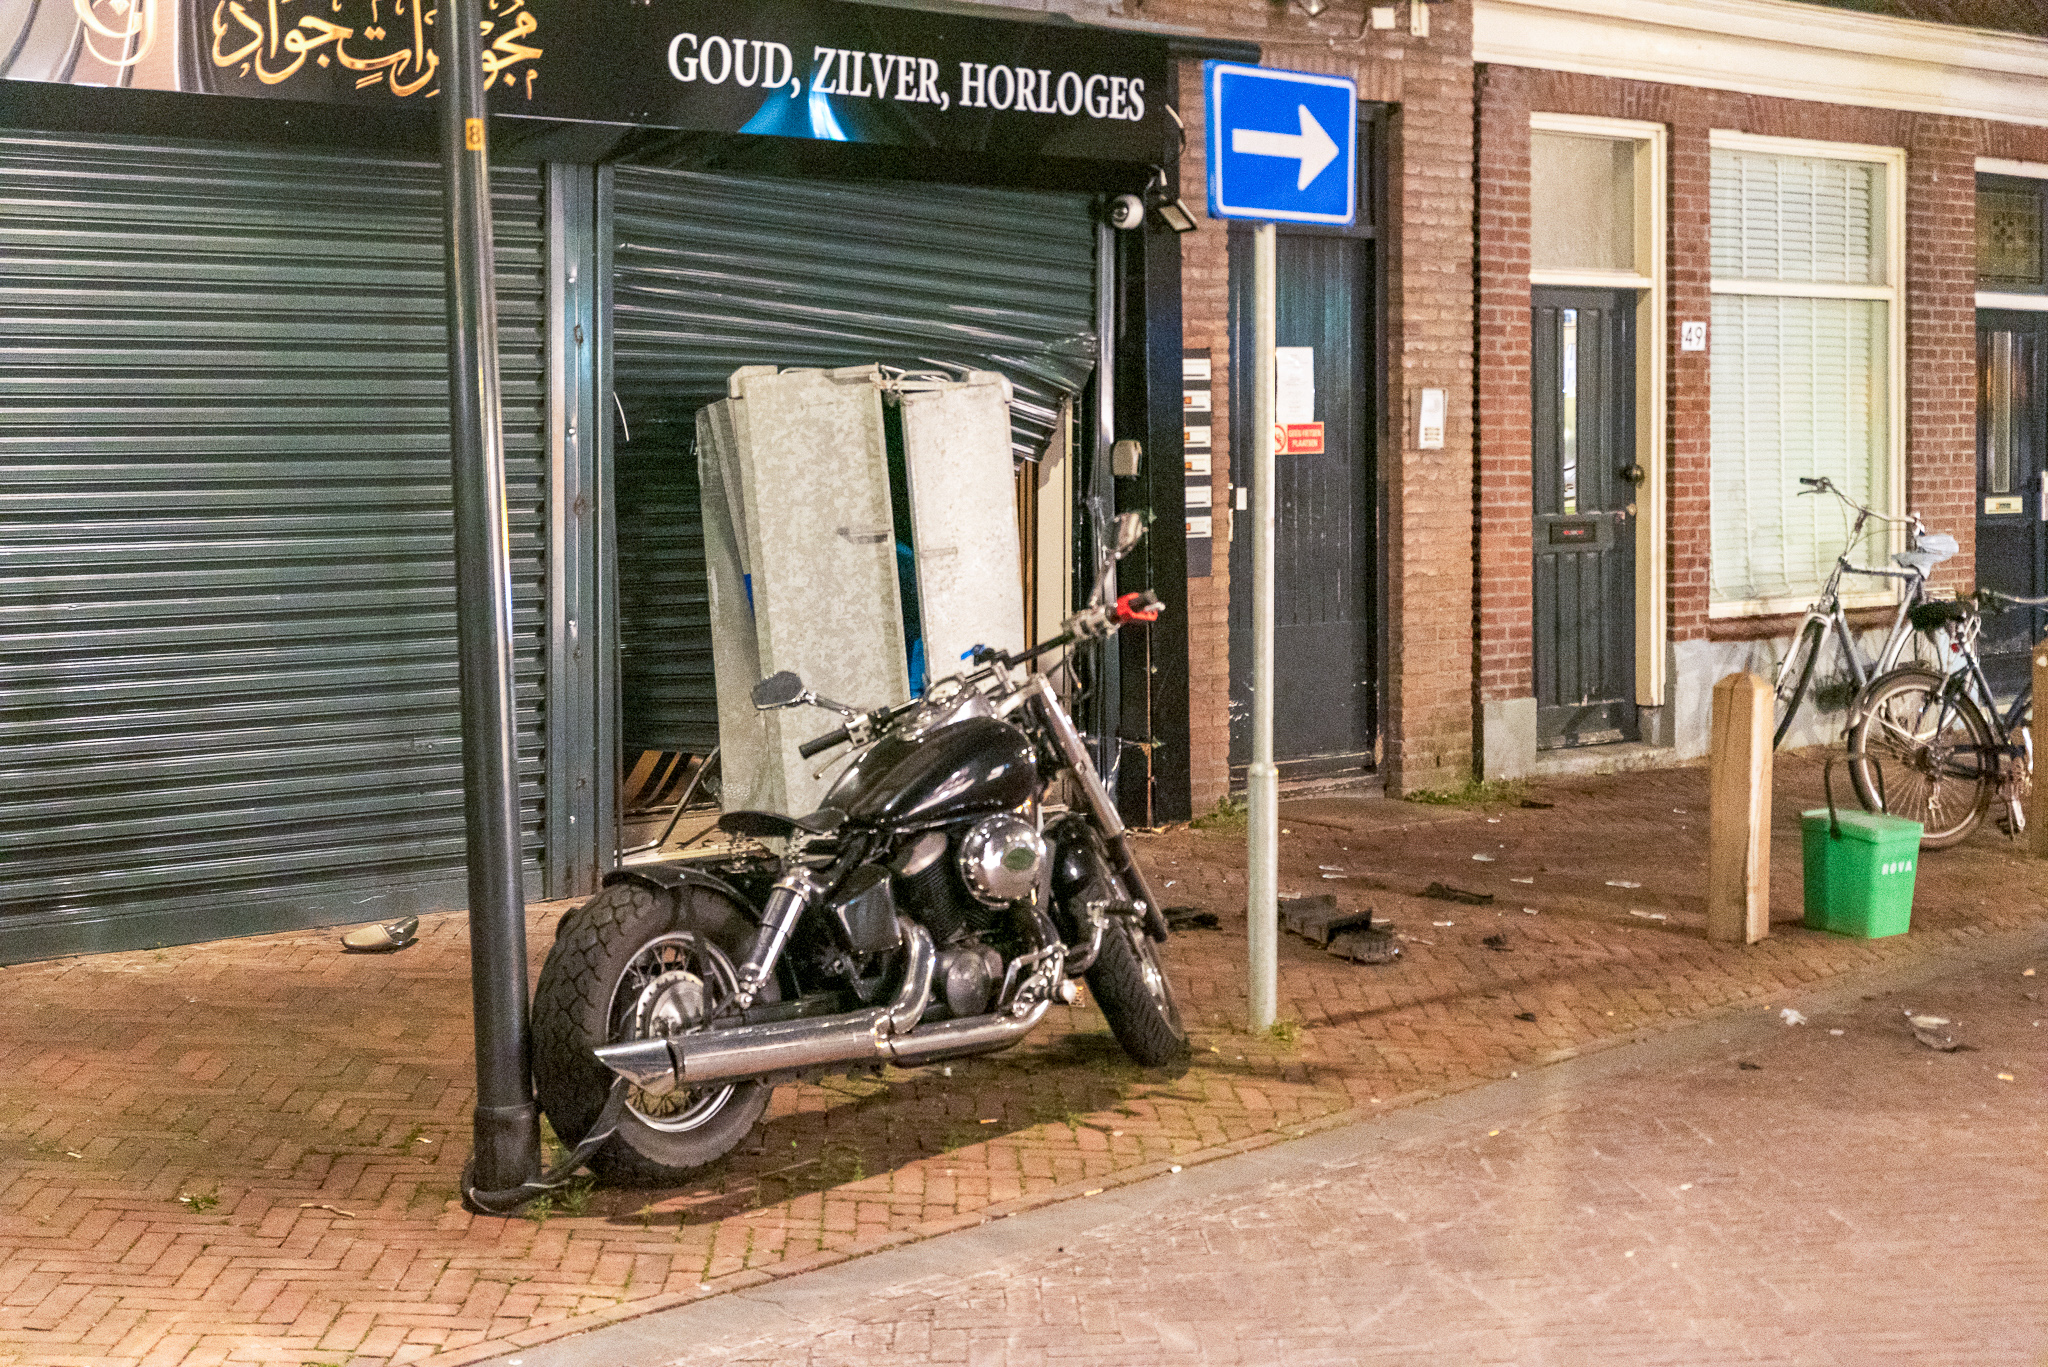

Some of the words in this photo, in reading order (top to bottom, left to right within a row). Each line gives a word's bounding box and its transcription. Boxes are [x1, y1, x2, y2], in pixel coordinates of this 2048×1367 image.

[337, 0, 544, 99] مجورات
[667, 32, 801, 99] GOUD,
[811, 44, 951, 112] ZILVER,
[958, 61, 1146, 122] HORLOGES
[1685, 326, 1703, 345] 49
